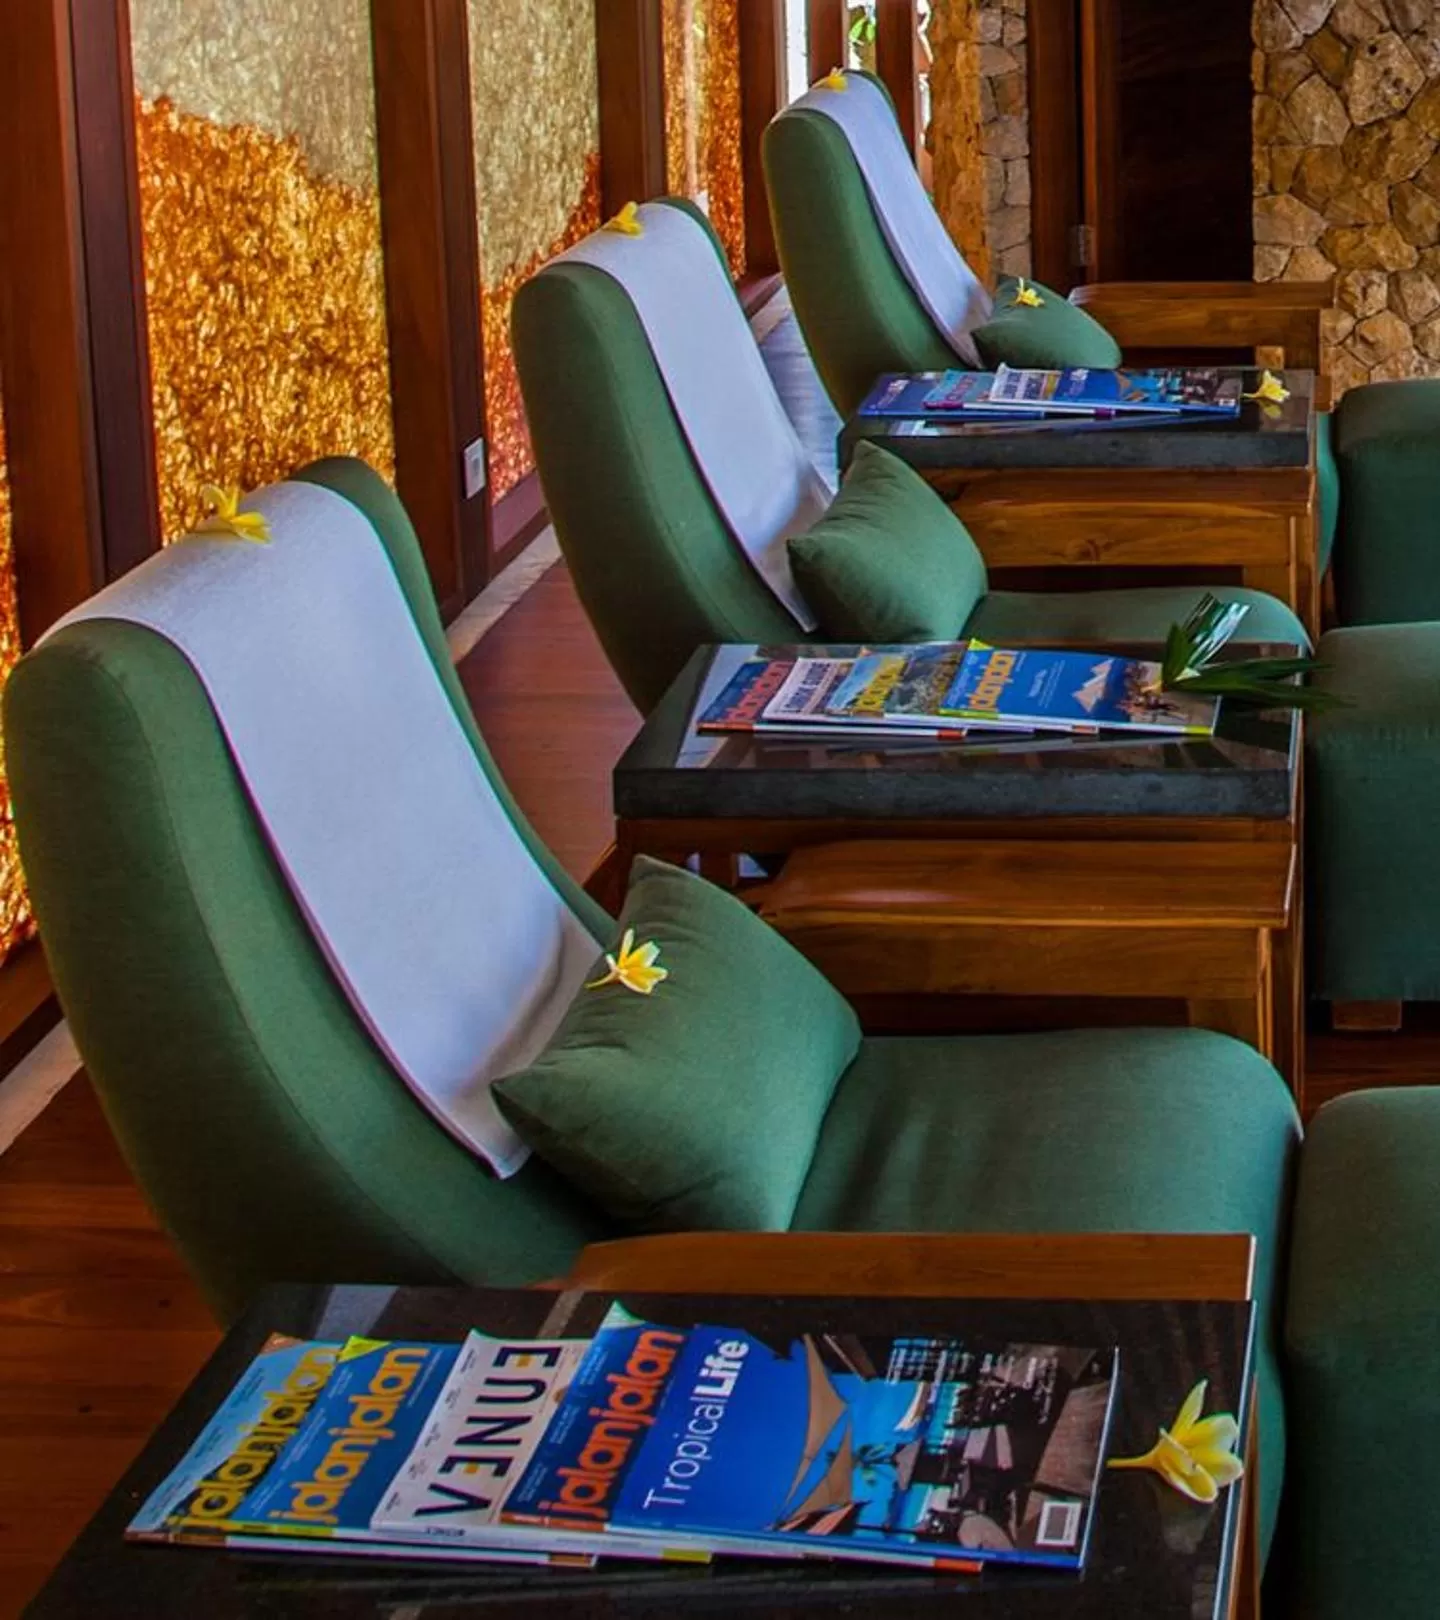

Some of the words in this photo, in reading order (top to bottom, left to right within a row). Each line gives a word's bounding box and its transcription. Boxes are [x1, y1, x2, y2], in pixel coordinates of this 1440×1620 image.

[166, 1347, 337, 1530] jalanjalan
[267, 1347, 430, 1523] jalanjalan
[413, 1347, 562, 1517] VENUE
[537, 1329, 684, 1518] jalanjalan
